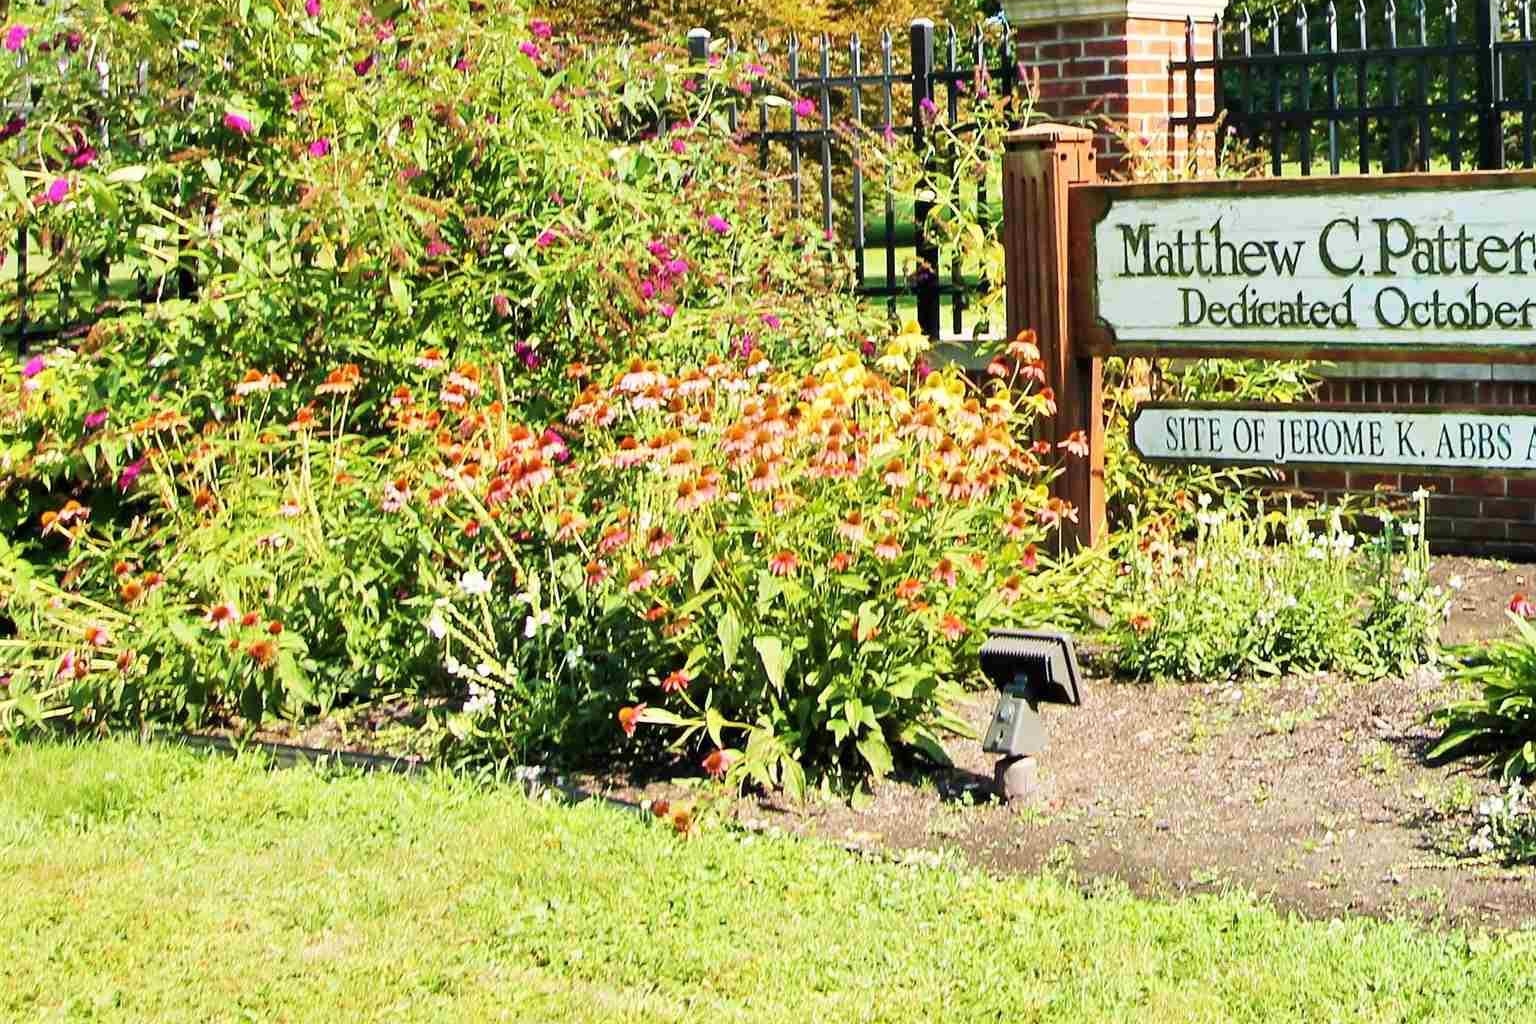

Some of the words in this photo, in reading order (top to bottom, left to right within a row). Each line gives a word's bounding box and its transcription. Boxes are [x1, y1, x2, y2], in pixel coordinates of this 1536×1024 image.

[1115, 215, 1305, 277] Matthew
[1177, 282, 1358, 328] Dedicated
[1165, 415, 1223, 453] SITE
[1232, 416, 1266, 454] OF
[1275, 418, 1385, 461] JEROME
[1395, 421, 1425, 458] K.
[1436, 422, 1512, 461] ABBS
